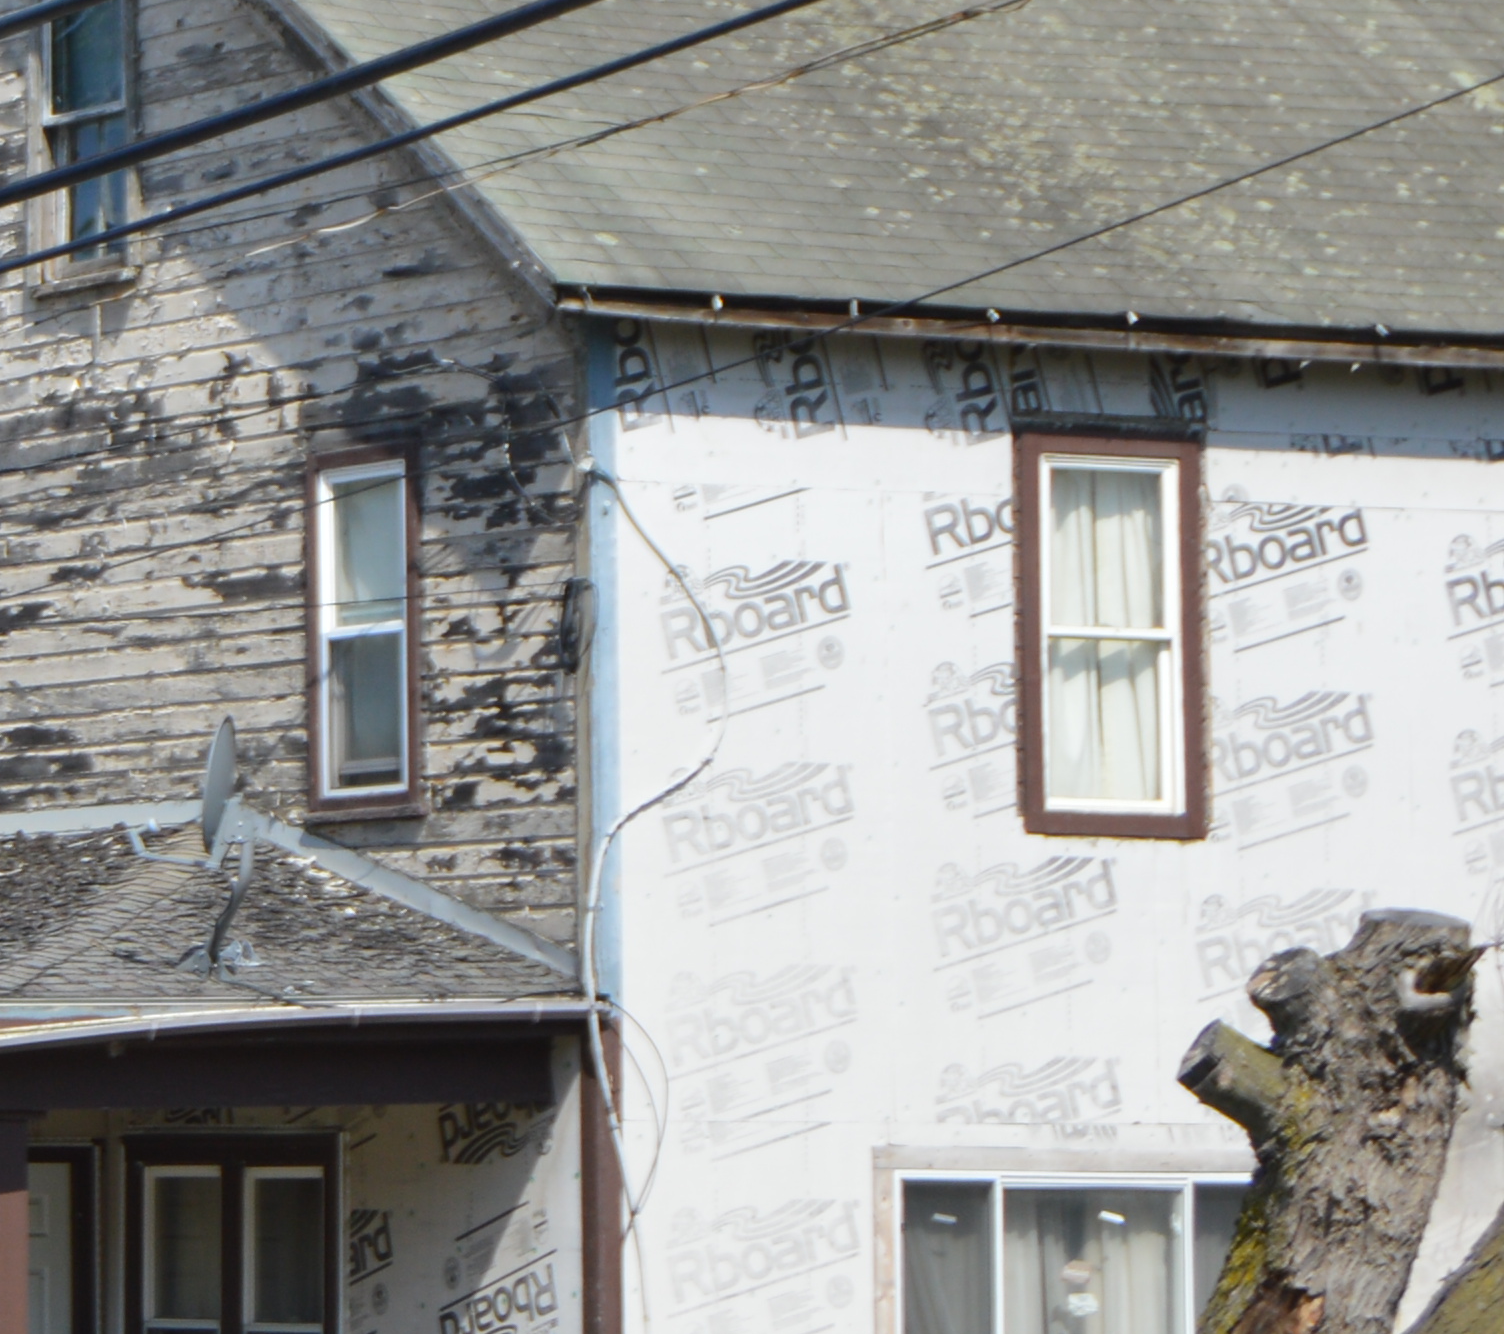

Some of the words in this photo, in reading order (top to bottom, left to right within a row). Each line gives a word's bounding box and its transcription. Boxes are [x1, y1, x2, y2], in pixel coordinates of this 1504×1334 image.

[659, 561, 852, 660] Rboard
[660, 763, 855, 864] Rboard
[931, 858, 1118, 958] Rboard
[665, 969, 857, 1067] Rboard
[666, 1201, 861, 1305] Rboard
